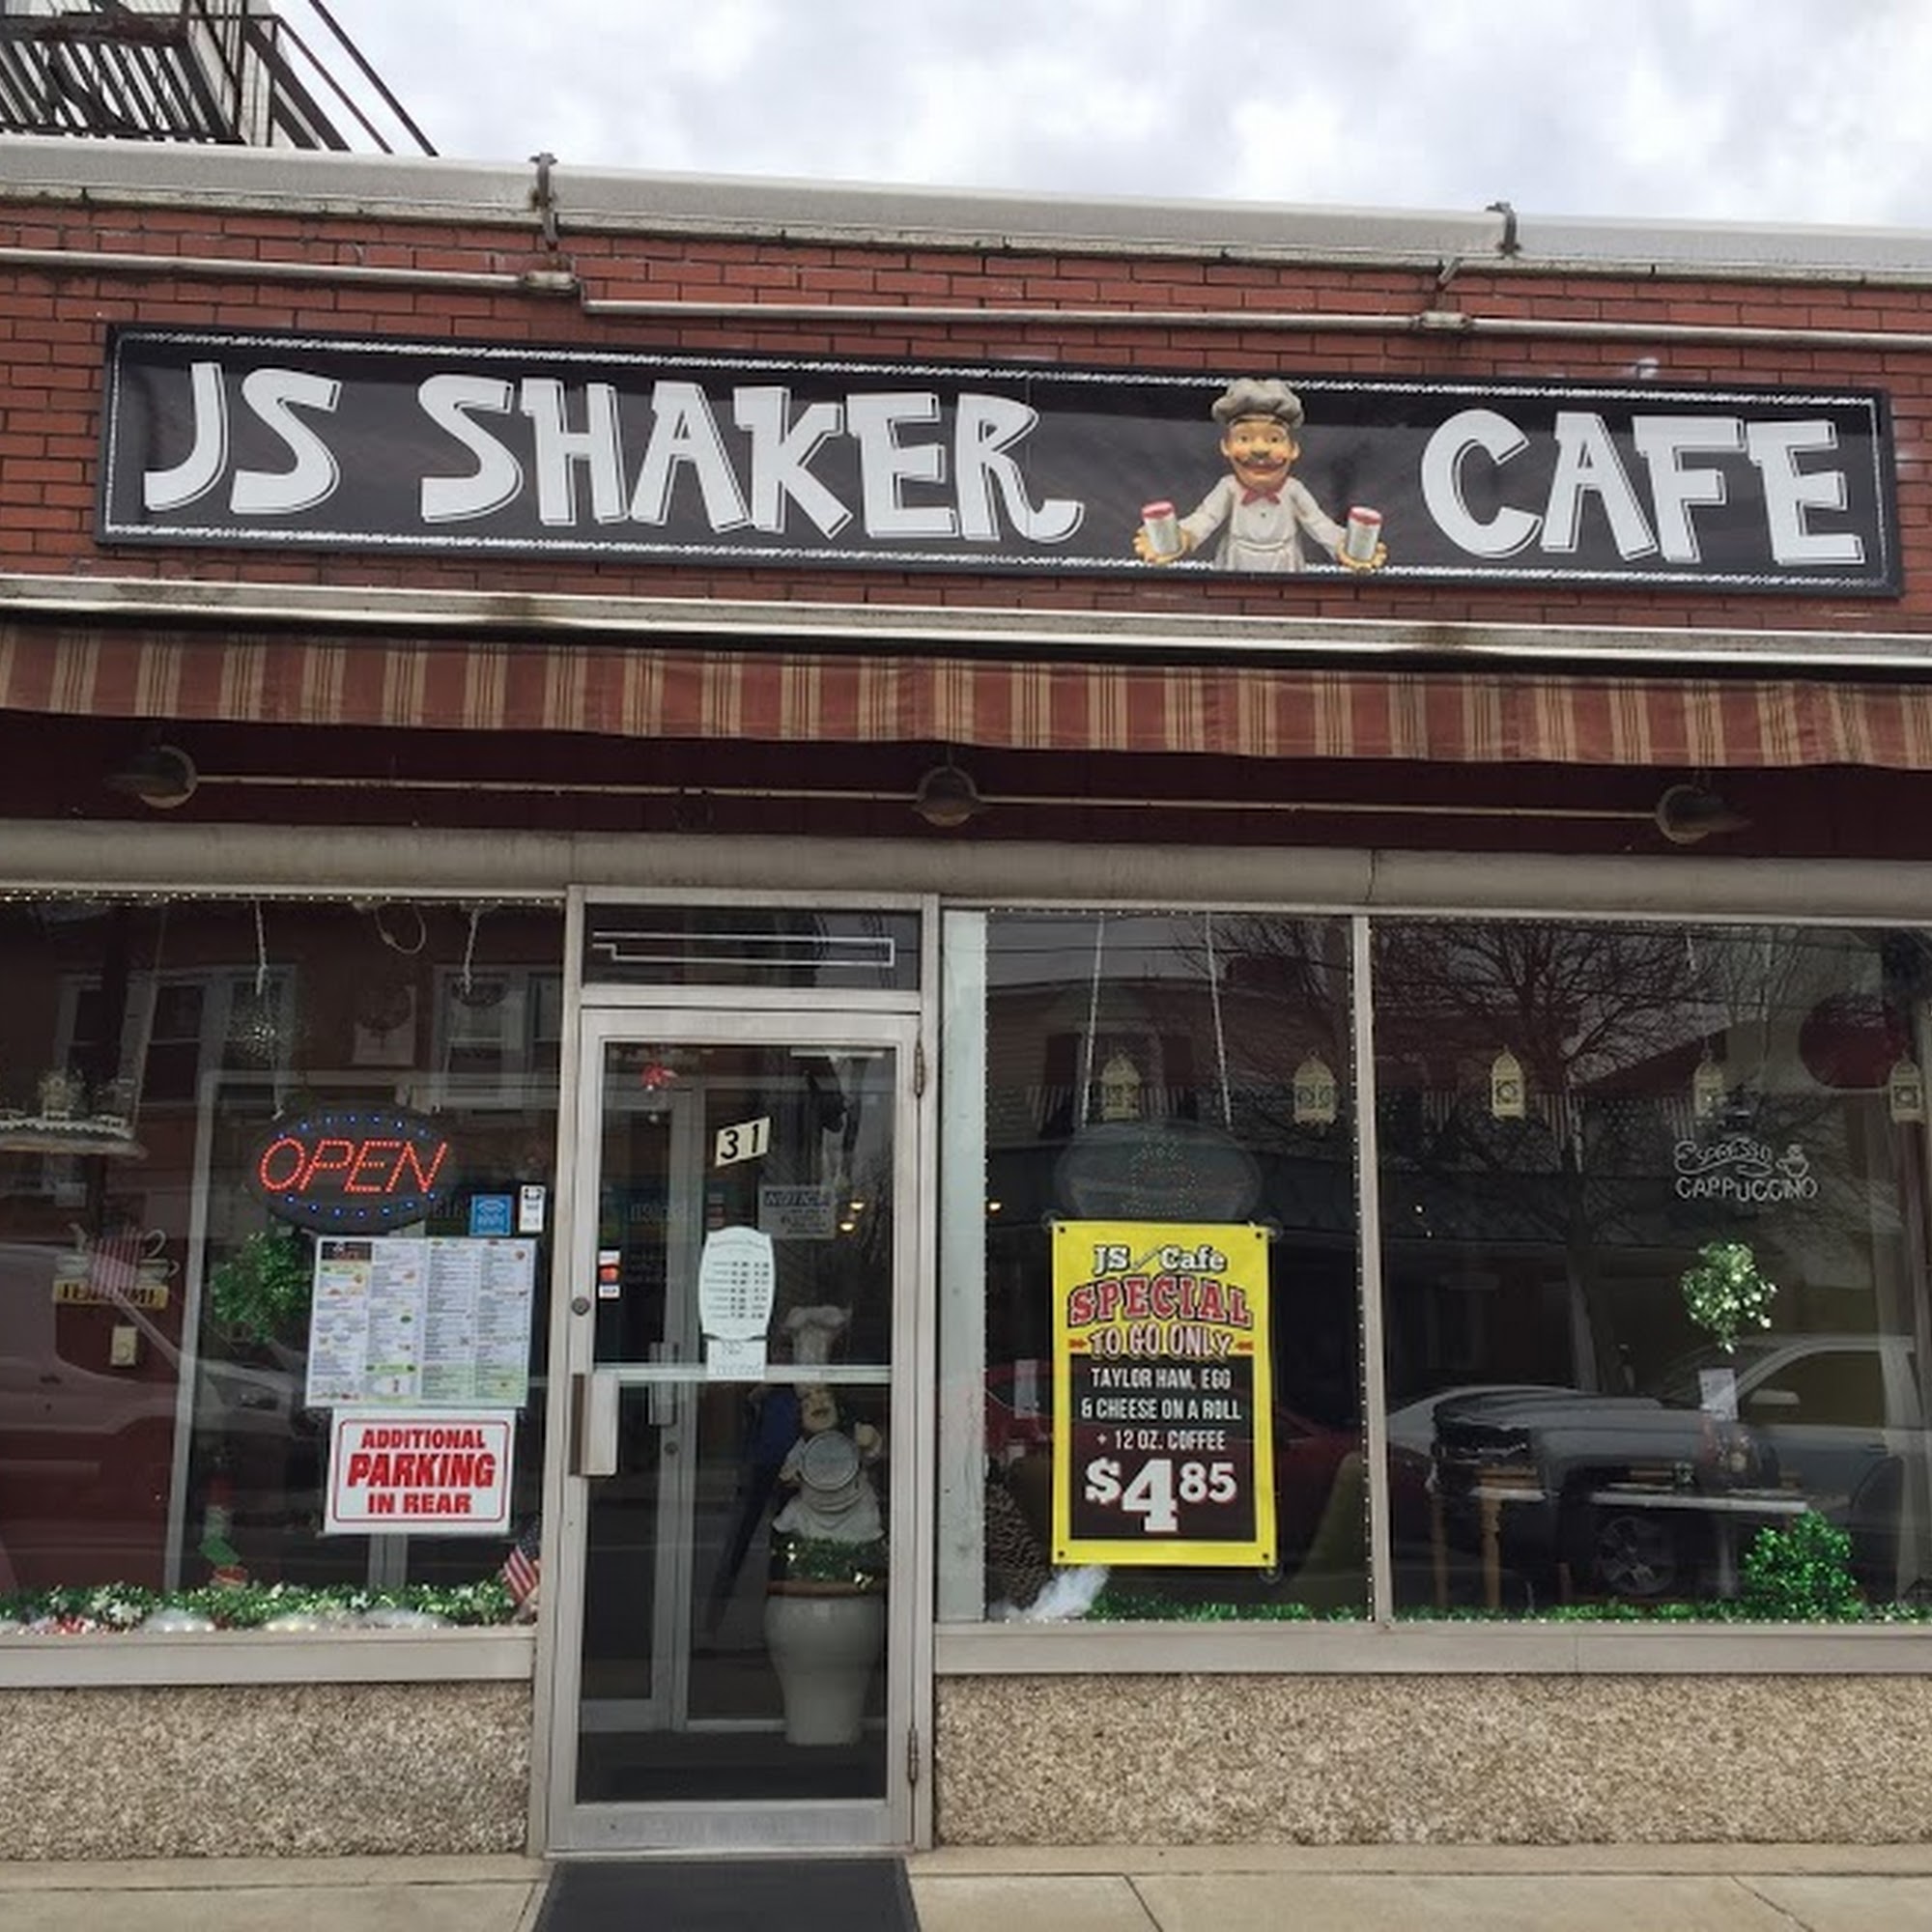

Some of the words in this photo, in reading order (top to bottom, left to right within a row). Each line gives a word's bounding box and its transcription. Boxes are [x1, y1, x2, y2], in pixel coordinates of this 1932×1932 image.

[143, 360, 343, 516] JS
[417, 374, 1085, 543] SHAKER
[1420, 409, 1866, 566] CAFE
[721, 1123, 761, 1160] 31
[258, 1137, 448, 1193] OPEN
[1674, 1176, 1819, 1202] CAPPUCCINO
[1093, 1245, 1129, 1276] JS
[1159, 1245, 1227, 1272] Cafe
[1067, 1273, 1253, 1330] SPECIAL
[1090, 1327, 1122, 1358] TO
[1128, 1322, 1161, 1357] GO
[1167, 1323, 1233, 1359] ONLY
[1091, 1367, 1152, 1388] TAYLOR
[1155, 1368, 1197, 1390] HAM,
[1201, 1368, 1232, 1390] EGG
[1081, 1398, 1094, 1418] &
[1095, 1398, 1158, 1419] CHEESE
[1161, 1398, 1184, 1419] ON
[1187, 1399, 1200, 1420] A
[1202, 1400, 1242, 1420] ROLL
[360, 1429, 486, 1449] ADDITIONAL
[1115, 1429, 1134, 1450] 12
[1137, 1429, 1164, 1450] OZ.
[1167, 1430, 1227, 1451] COFFEE
[347, 1452, 497, 1489] PARKING
[367, 1492, 396, 1515] IN
[402, 1493, 473, 1515] REAR
